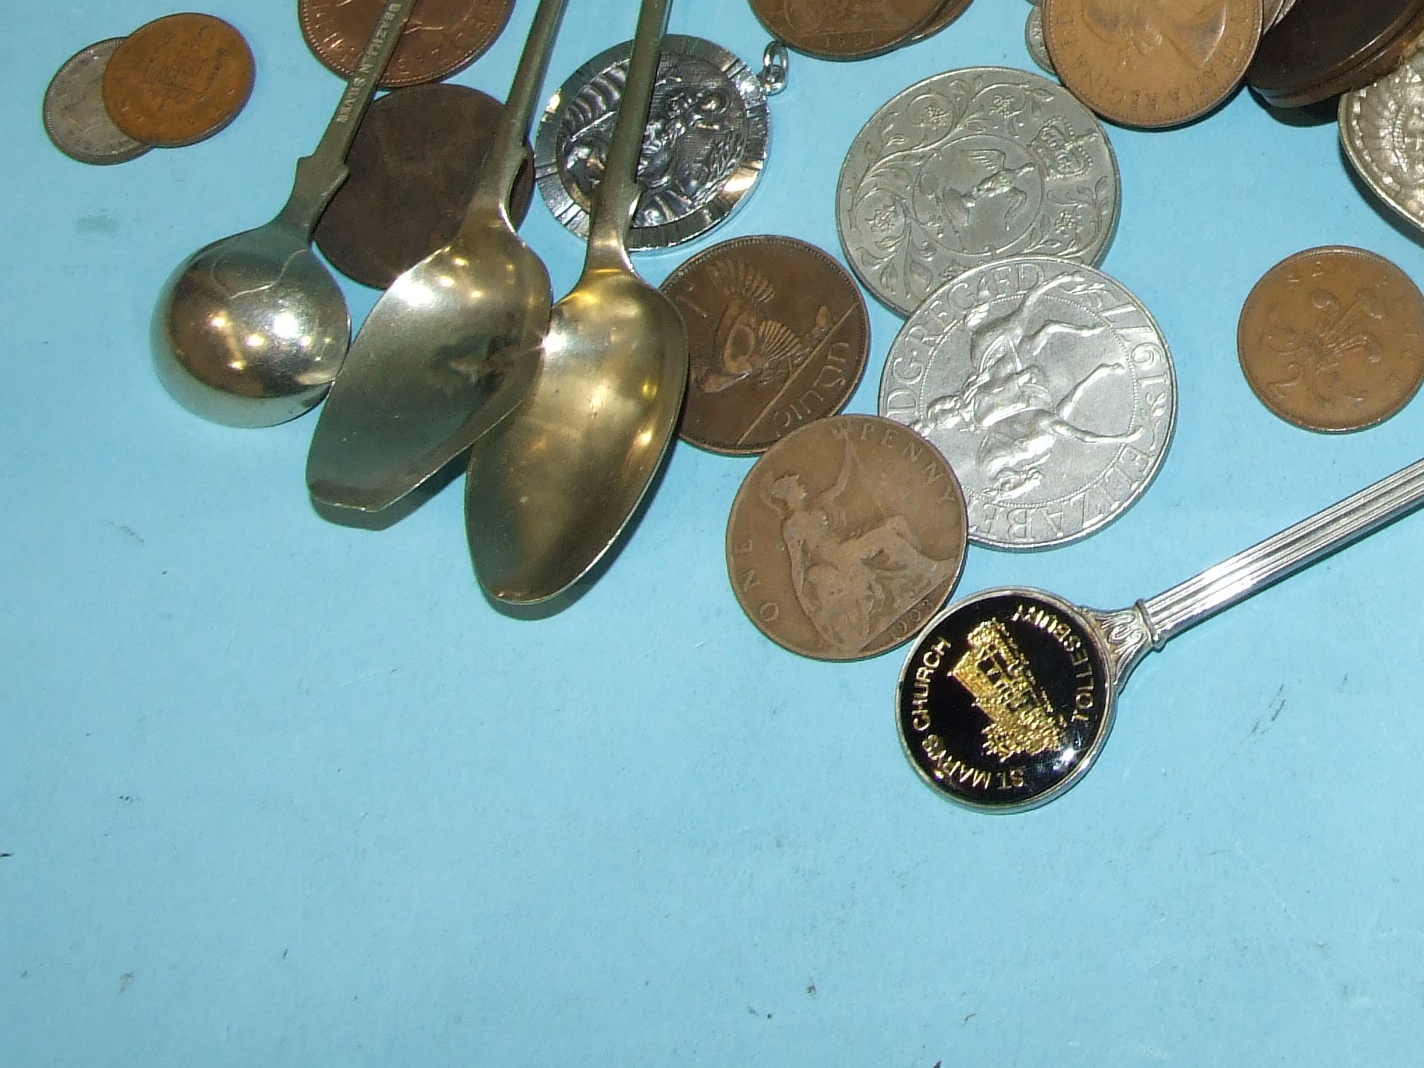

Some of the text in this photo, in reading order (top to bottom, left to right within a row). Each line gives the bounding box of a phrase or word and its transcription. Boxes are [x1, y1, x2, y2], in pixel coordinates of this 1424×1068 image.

[734, 423, 957, 622] ONE PENNY
[887, 598, 934, 640] 1903
[911, 636, 952, 732] CHURCH
